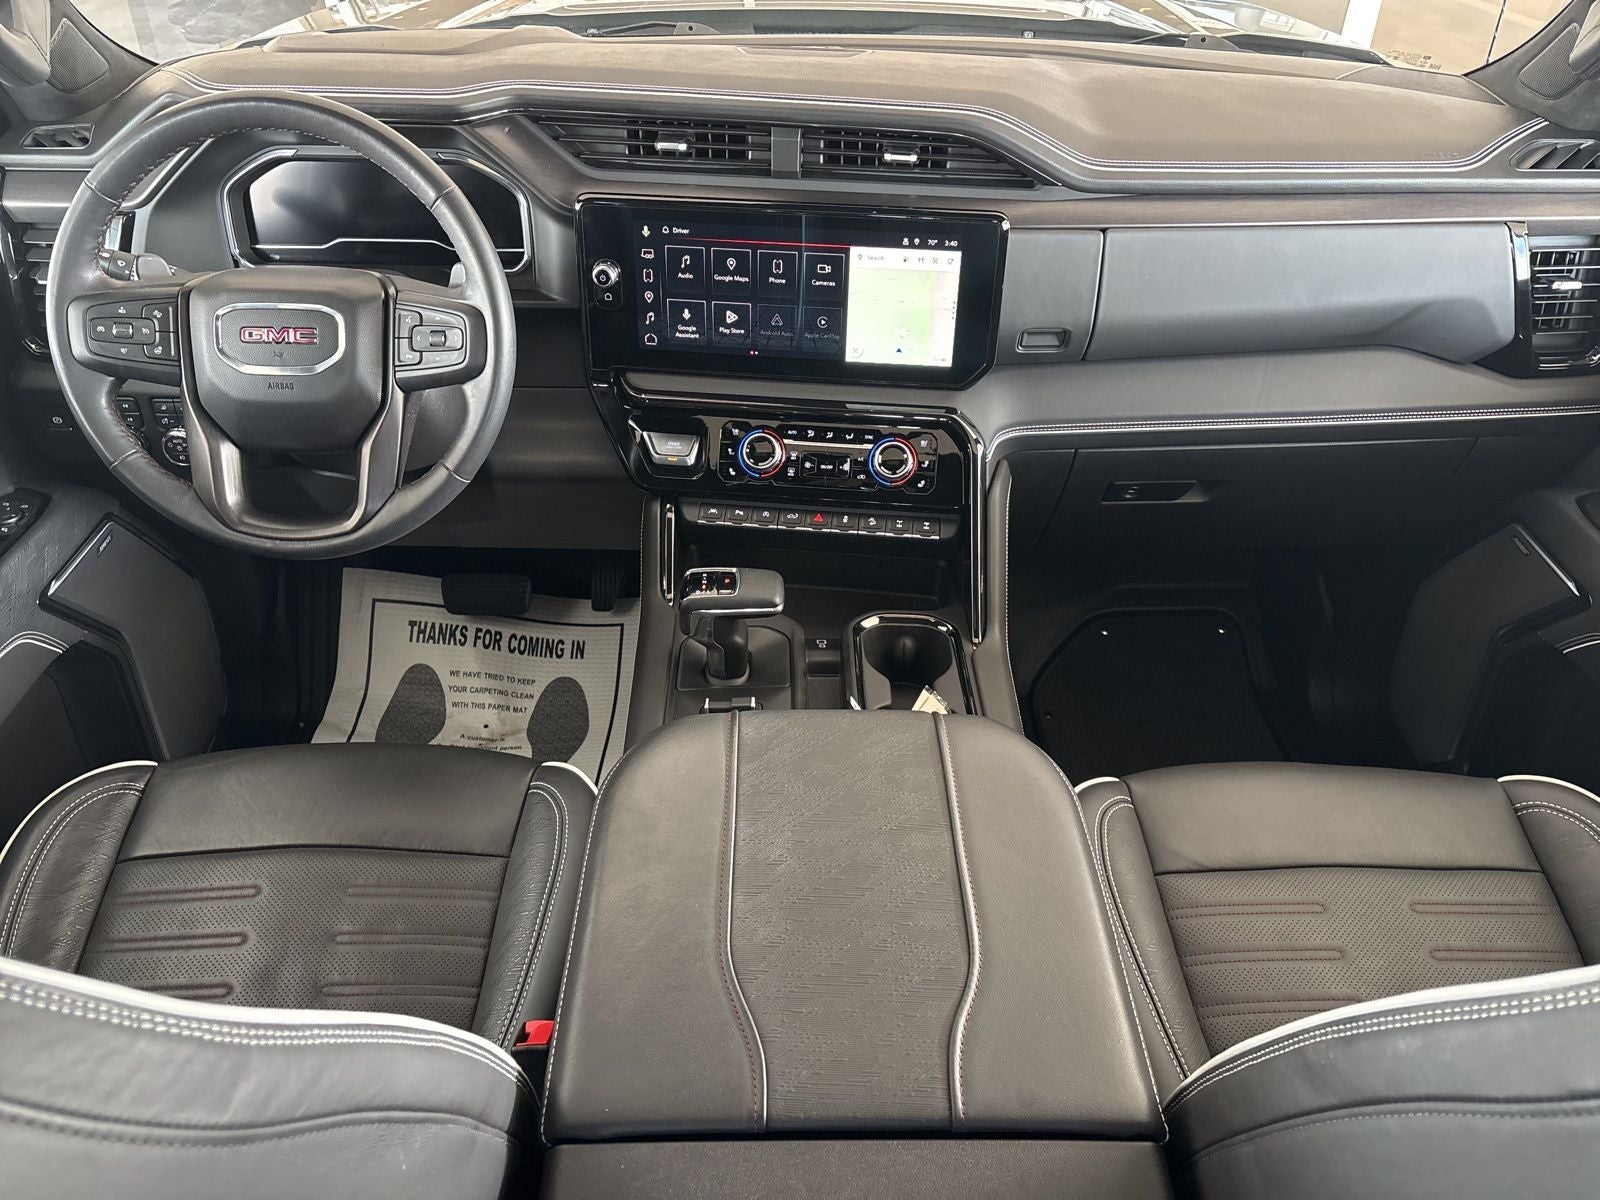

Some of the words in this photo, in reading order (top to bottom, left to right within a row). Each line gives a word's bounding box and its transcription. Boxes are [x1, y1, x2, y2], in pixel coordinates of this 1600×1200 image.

[713, 274, 733, 282] Google
[768, 276, 786, 284] Phone
[677, 324, 697, 332] Google
[719, 326, 730, 334] Play
[240, 326, 318, 345] GMC
[267, 382, 295, 390] AIRBAG
[407, 620, 469, 647] THANKS
[473, 627, 503, 652] FOR
[507, 633, 566, 660] COMING
[569, 640, 586, 660] IN
[449, 669, 461, 677] WE
[462, 671, 482, 679] HAVE
[484, 672, 504, 682] TRIED
[506, 676, 516, 684] TO
[517, 678, 536, 686] KEEP
[448, 684, 468, 694] YOUR
[469, 686, 509, 697] CARPETING
[510, 691, 535, 700] CLEAN
[451, 701, 469, 709] WITH
[471, 702, 486, 710] THIS
[487, 703, 511, 713] PAPER
[512, 706, 528, 714] MAT
